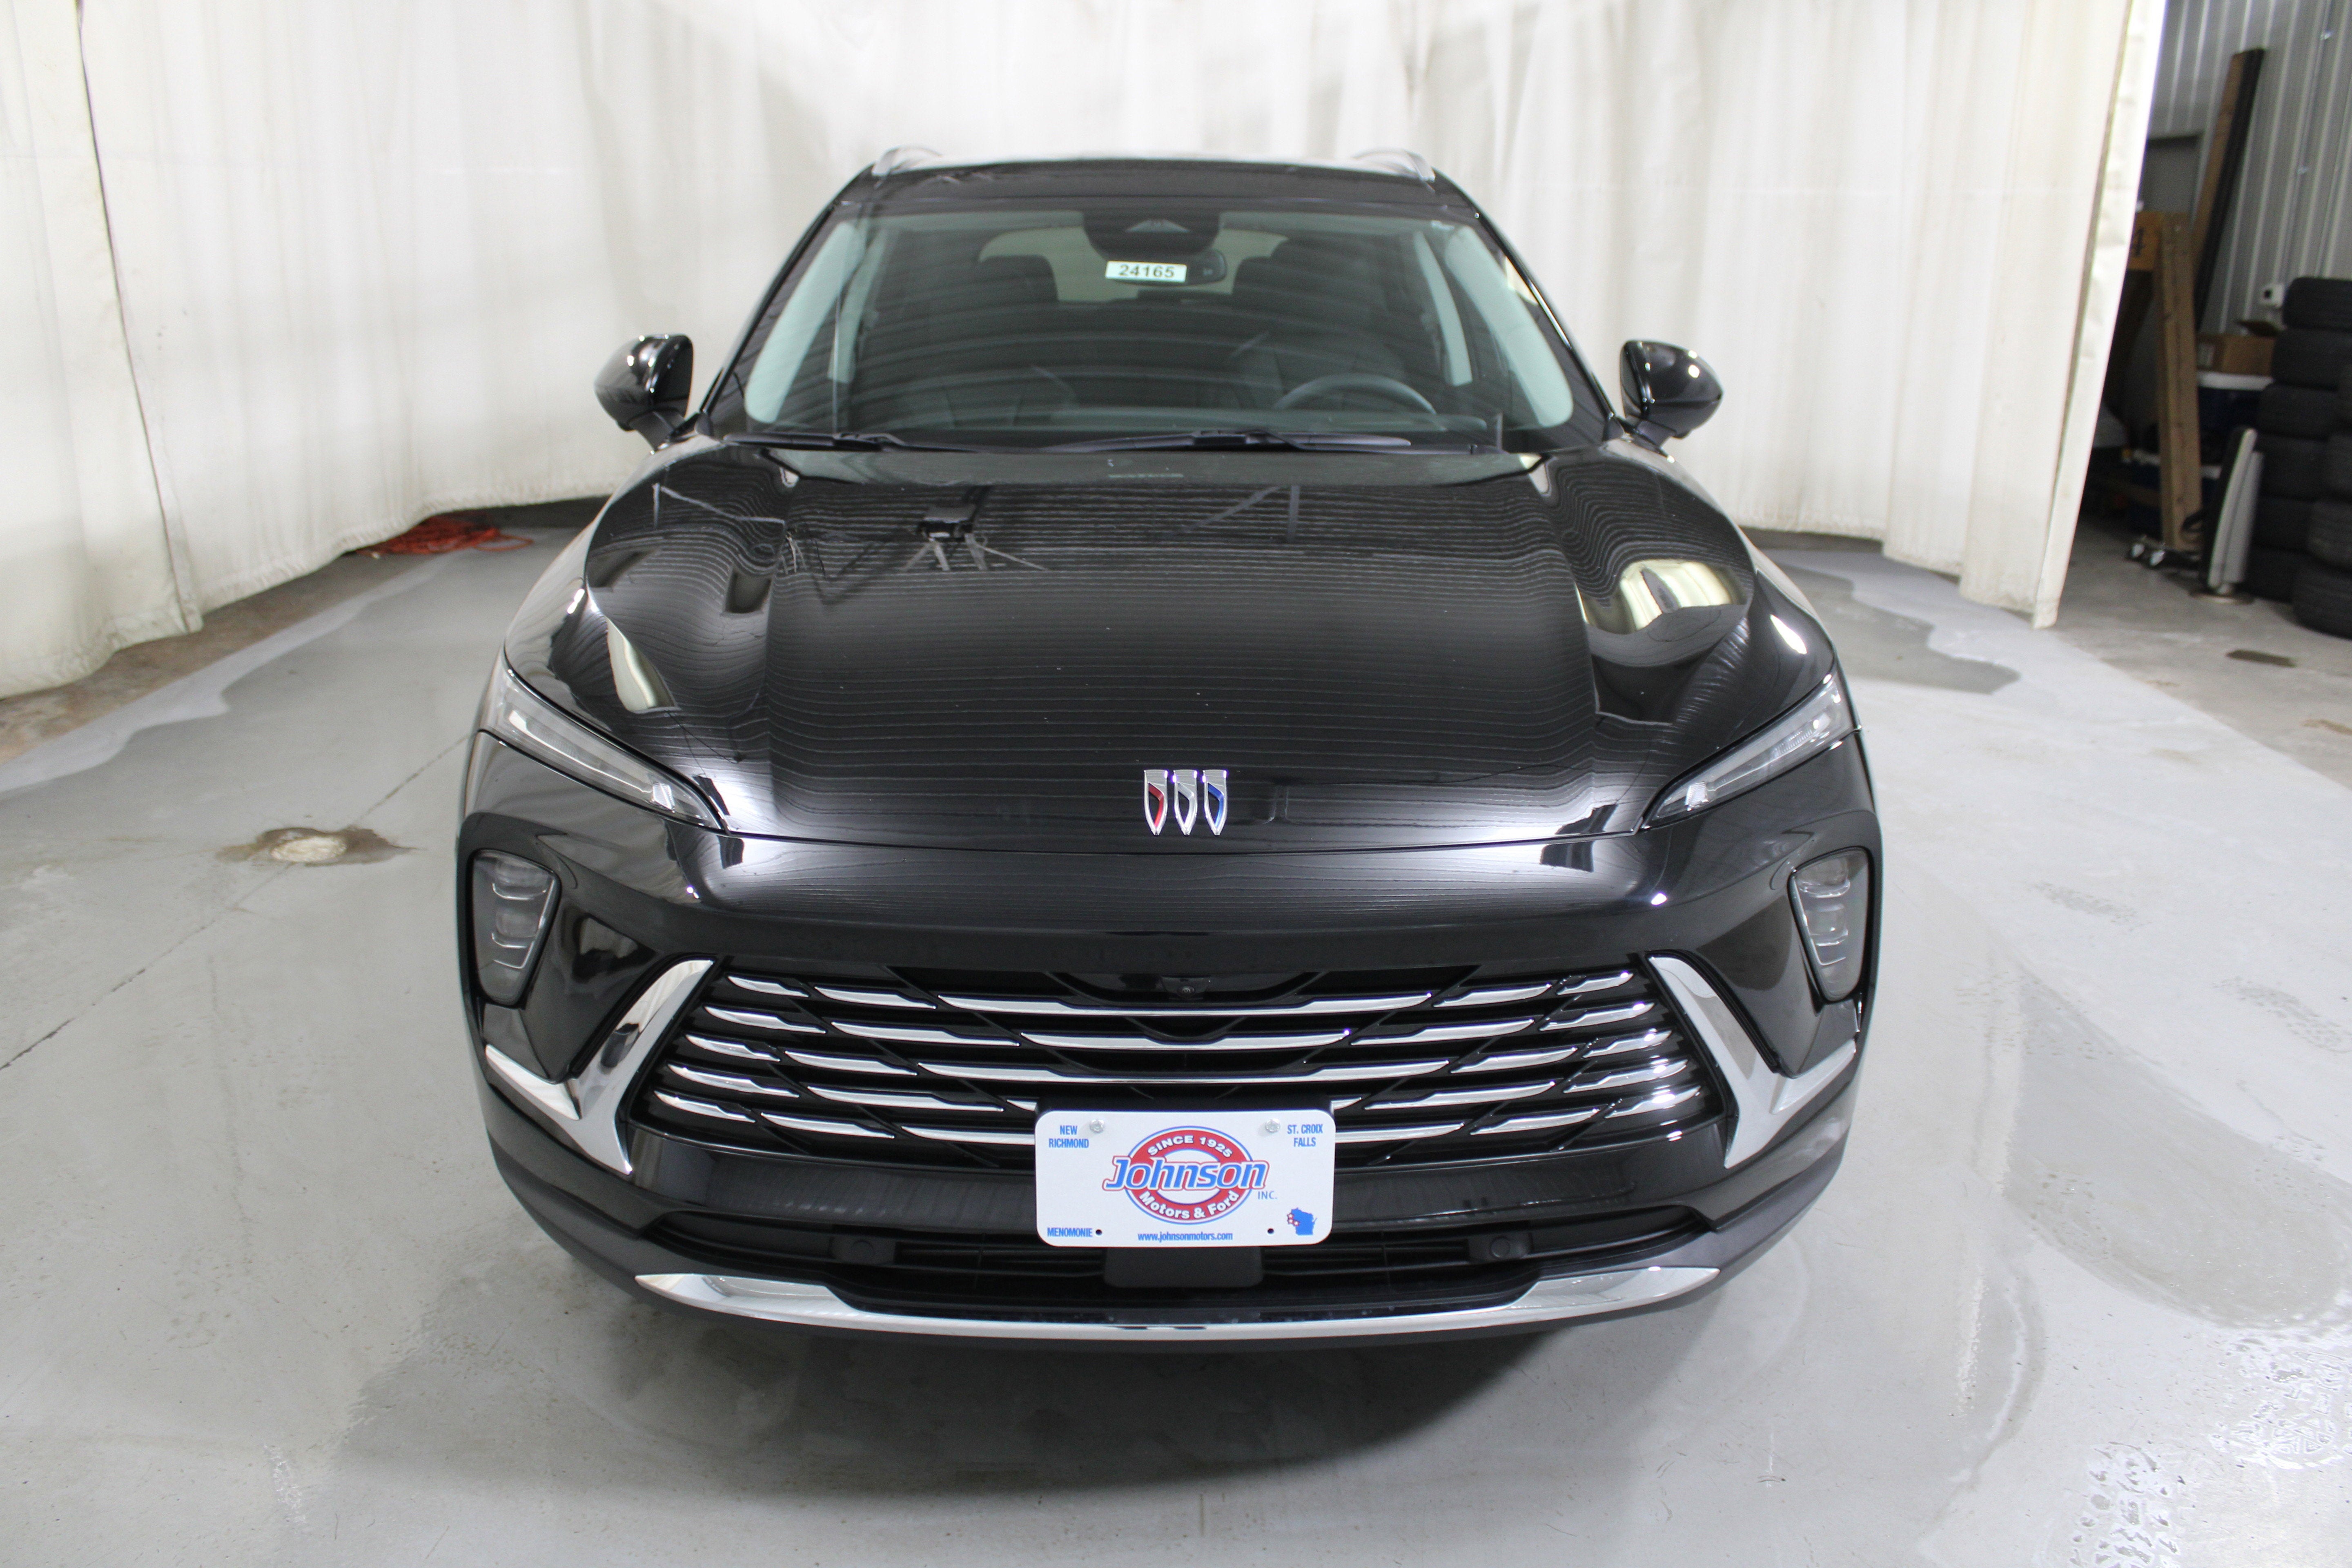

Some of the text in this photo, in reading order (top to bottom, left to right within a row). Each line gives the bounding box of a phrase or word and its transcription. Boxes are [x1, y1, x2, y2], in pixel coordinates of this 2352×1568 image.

[1118, 265, 1174, 278] 24165
[1059, 1125, 1078, 1135] NEW
[1287, 1124, 1323, 1134] ST. CROIX
[1048, 1138, 1089, 1148] RICHMOND
[1147, 1135, 1233, 1158] SINCE 1925
[1294, 1137, 1316, 1147] FALLS
[1105, 1159, 1267, 1188] Johnson
[1258, 1191, 1278, 1200] INC.
[1138, 1189, 1240, 1220] Motors & Ford
[1047, 1227, 1093, 1238] MENOMONIE
[1138, 1231, 1233, 1243] www.johnsonmotors.com
